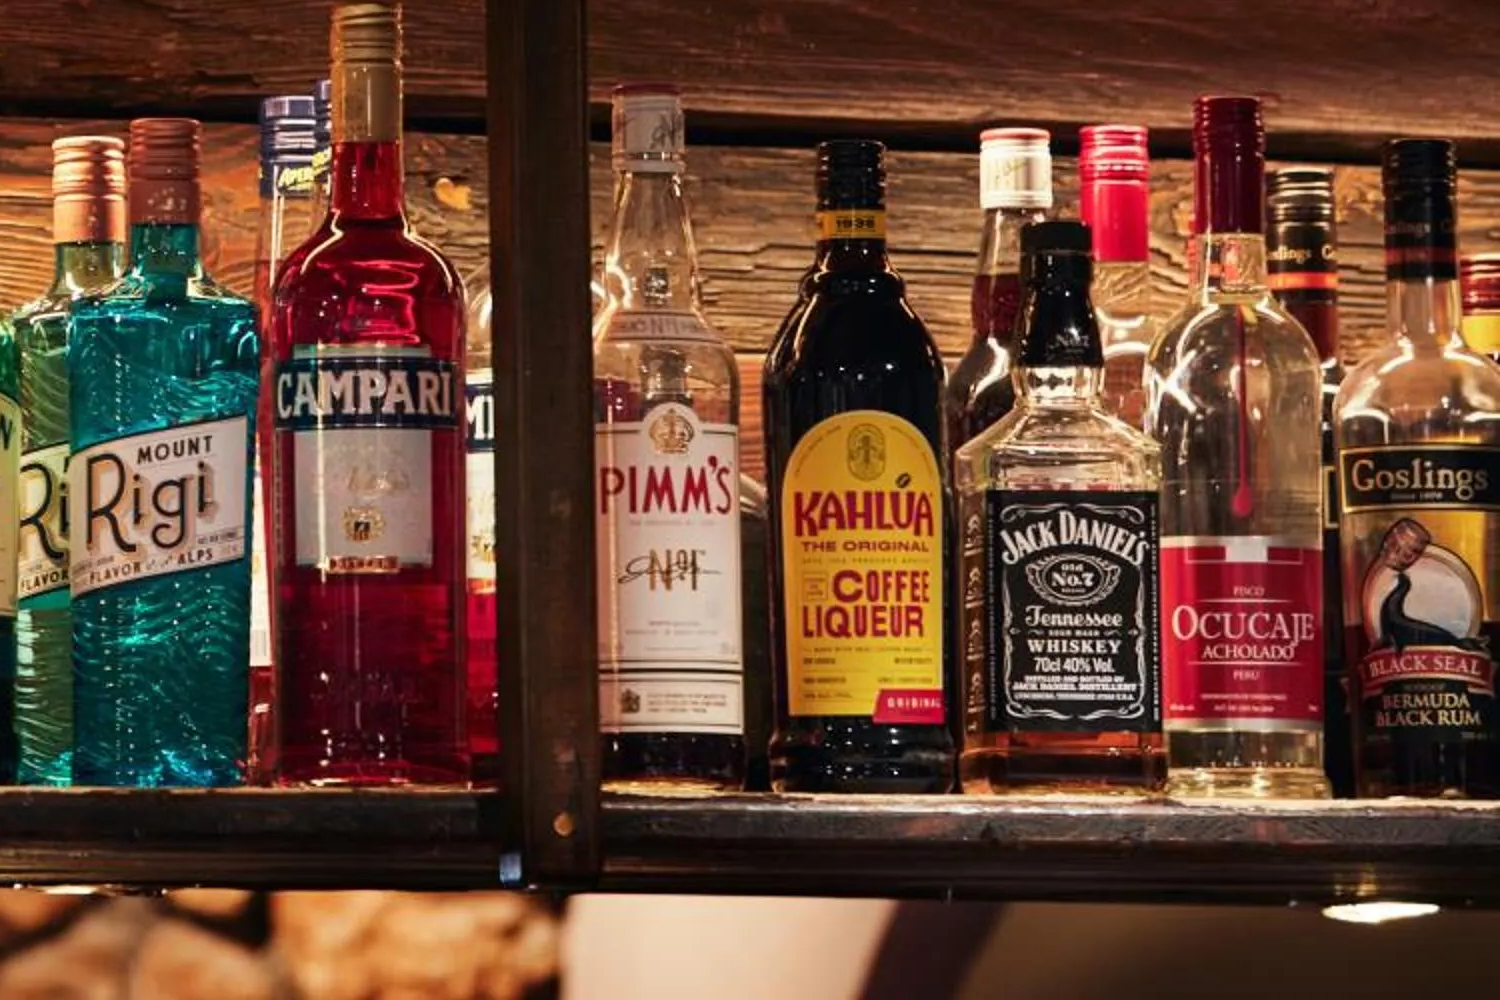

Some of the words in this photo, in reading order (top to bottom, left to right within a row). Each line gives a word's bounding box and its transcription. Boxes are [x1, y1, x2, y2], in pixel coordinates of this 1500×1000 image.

[276, 369, 453, 420] CAMPARI
[137, 435, 213, 464] MOUNT
[601, 456, 732, 515] PIMM'S
[1352, 458, 1489, 500] Goslings
[87, 453, 207, 553] Rigi
[794, 472, 934, 537] KAHLÚA
[801, 541, 836, 552] THE
[843, 540, 930, 552] ORIGINAL
[1000, 518, 1056, 565] JACK
[1058, 510, 1150, 566] DANIEL'S
[178, 547, 213, 565] ALPS
[90, 562, 141, 585] FLAVOR
[832, 569, 930, 603] COFFEE
[802, 605, 925, 639] LIQUEUR
[1025, 605, 1123, 627] Tennessee
[1171, 605, 1315, 647] OCUCAJE
[1027, 639, 1122, 654] WHISKEY
[1202, 644, 1296, 660] ACHOLADO
[1034, 657, 1061, 673] 70cl
[1063, 657, 1091, 673] 40%
[1369, 655, 1431, 678] BLACK
[1434, 656, 1482, 676] SEAL
[1382, 693, 1471, 709] BERMUDA
[1375, 710, 1435, 727] BLACK
[1437, 709, 1482, 726] RUM
